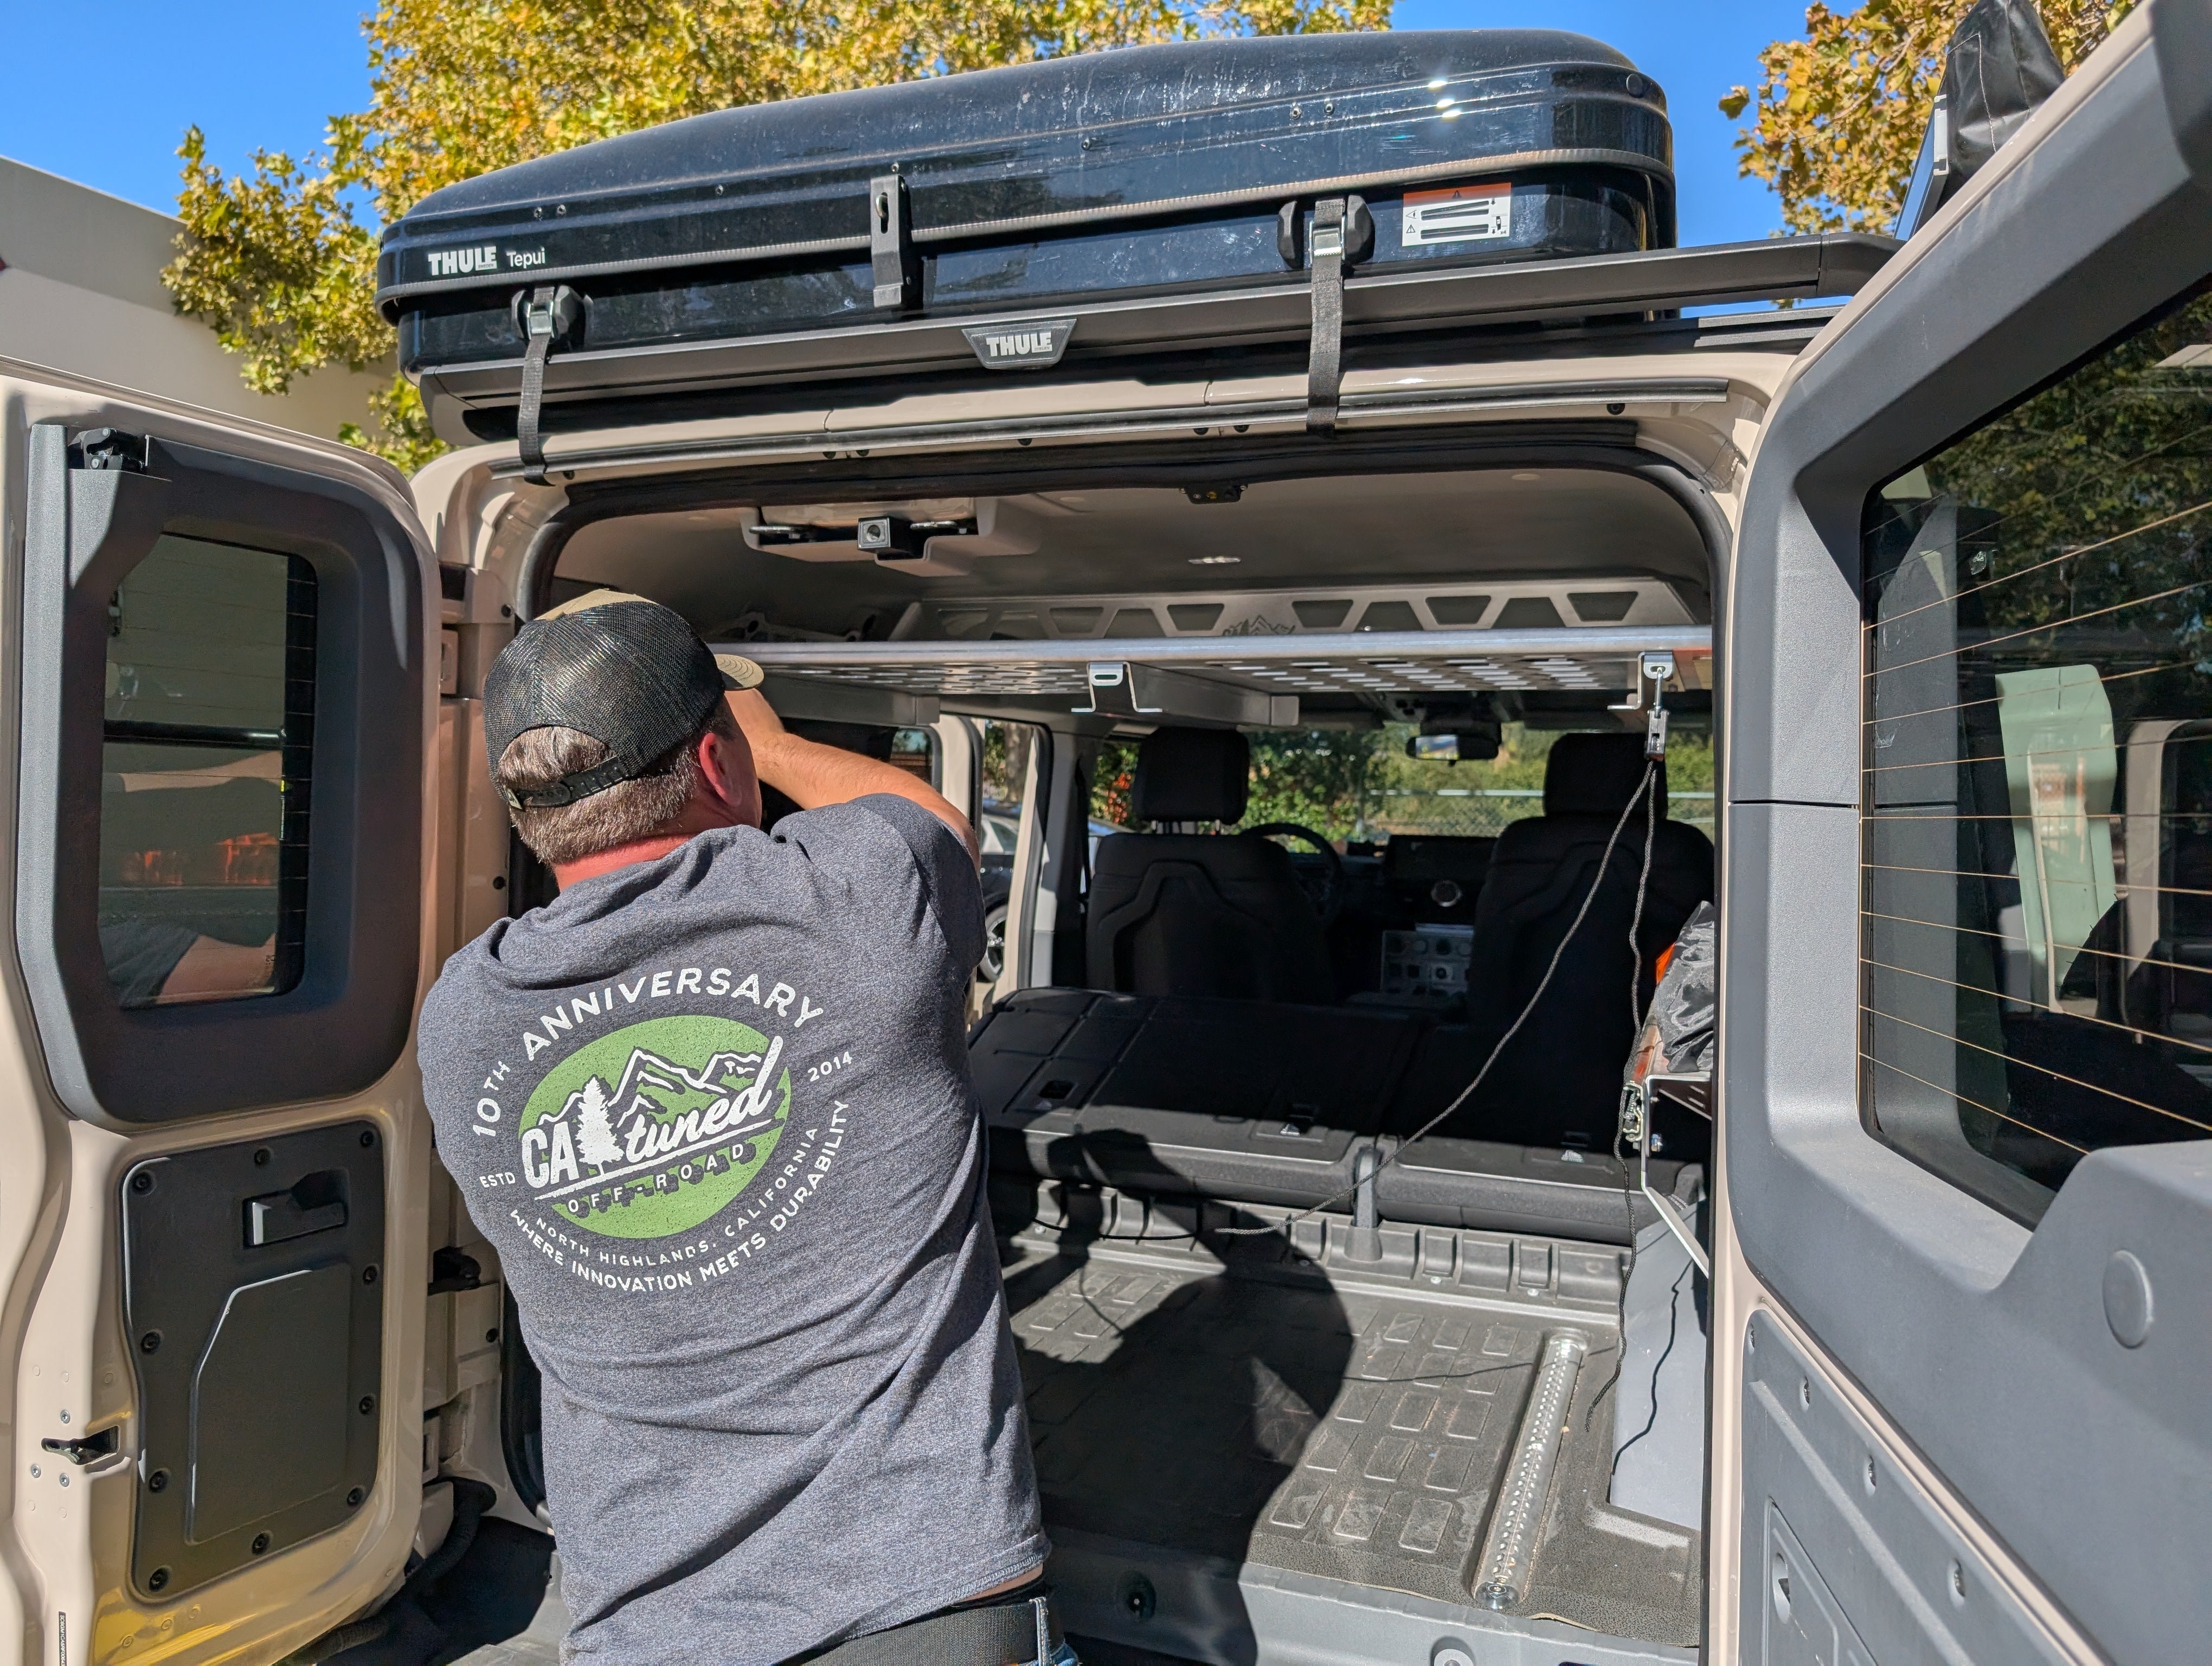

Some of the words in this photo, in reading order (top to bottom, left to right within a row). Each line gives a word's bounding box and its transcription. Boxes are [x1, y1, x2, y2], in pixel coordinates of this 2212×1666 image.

[428, 246, 497, 276] THULE
[505, 247, 545, 269] Tepui
[986, 332, 1053, 357] THULE
[472, 1060, 511, 1137] 10TH
[523, 967, 824, 1061] ANNIVERSARY
[807, 1050, 853, 1082] 2014
[522, 1118, 580, 1191] CA
[624, 1035, 784, 1164] tuned
[479, 1171, 516, 1188] ESTD
[510, 1209, 567, 1266] WHERE
[572, 1260, 693, 1292] INNOVATION
[699, 1233, 766, 1281] MEETS
[770, 1100, 849, 1232] DURABILITY
[536, 1217, 589, 1257] NORTH
[725, 1128, 818, 1236] CALIFORNIA
[568, 1143, 743, 1213] OFF-ROAD
